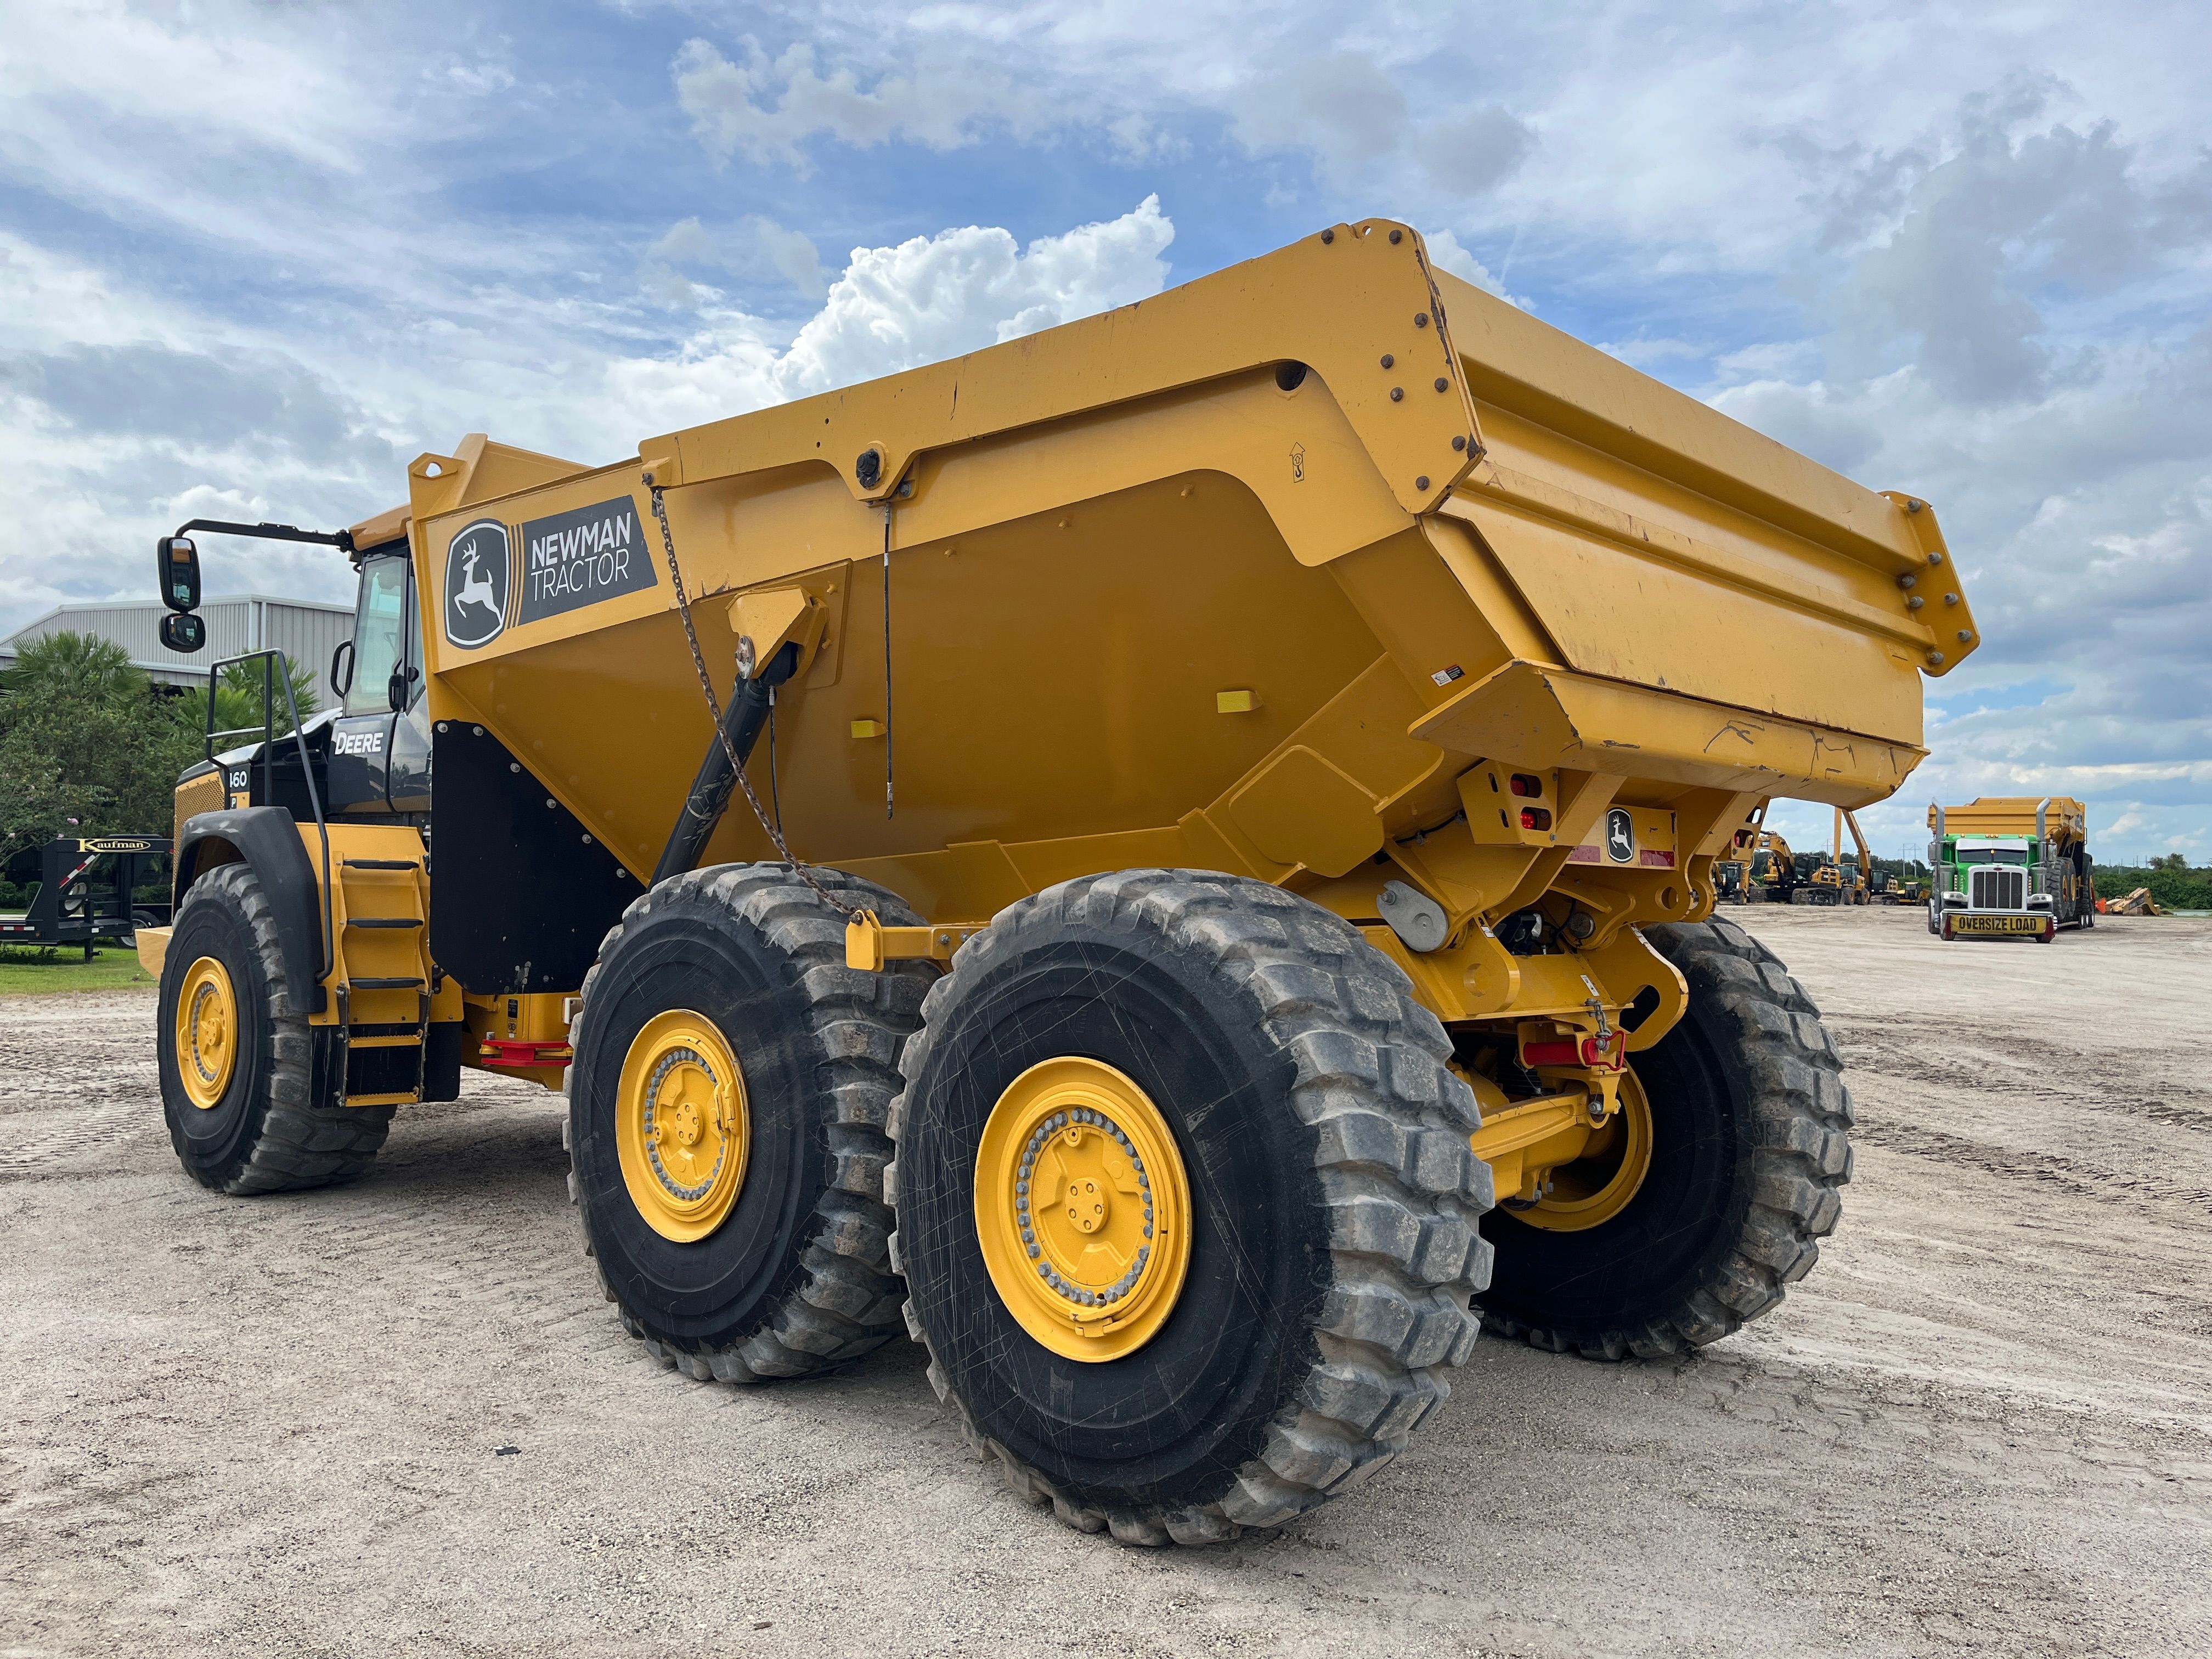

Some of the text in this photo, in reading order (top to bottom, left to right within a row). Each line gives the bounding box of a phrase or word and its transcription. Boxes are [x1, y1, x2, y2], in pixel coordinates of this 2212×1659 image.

[532, 512, 631, 569] NEWMAN
[531, 548, 629, 601] TRACTOR
[335, 732, 383, 755] DEERE
[76, 838, 144, 853] Kaufman
[1959, 917, 2037, 931] OVERSIZE LOAD
